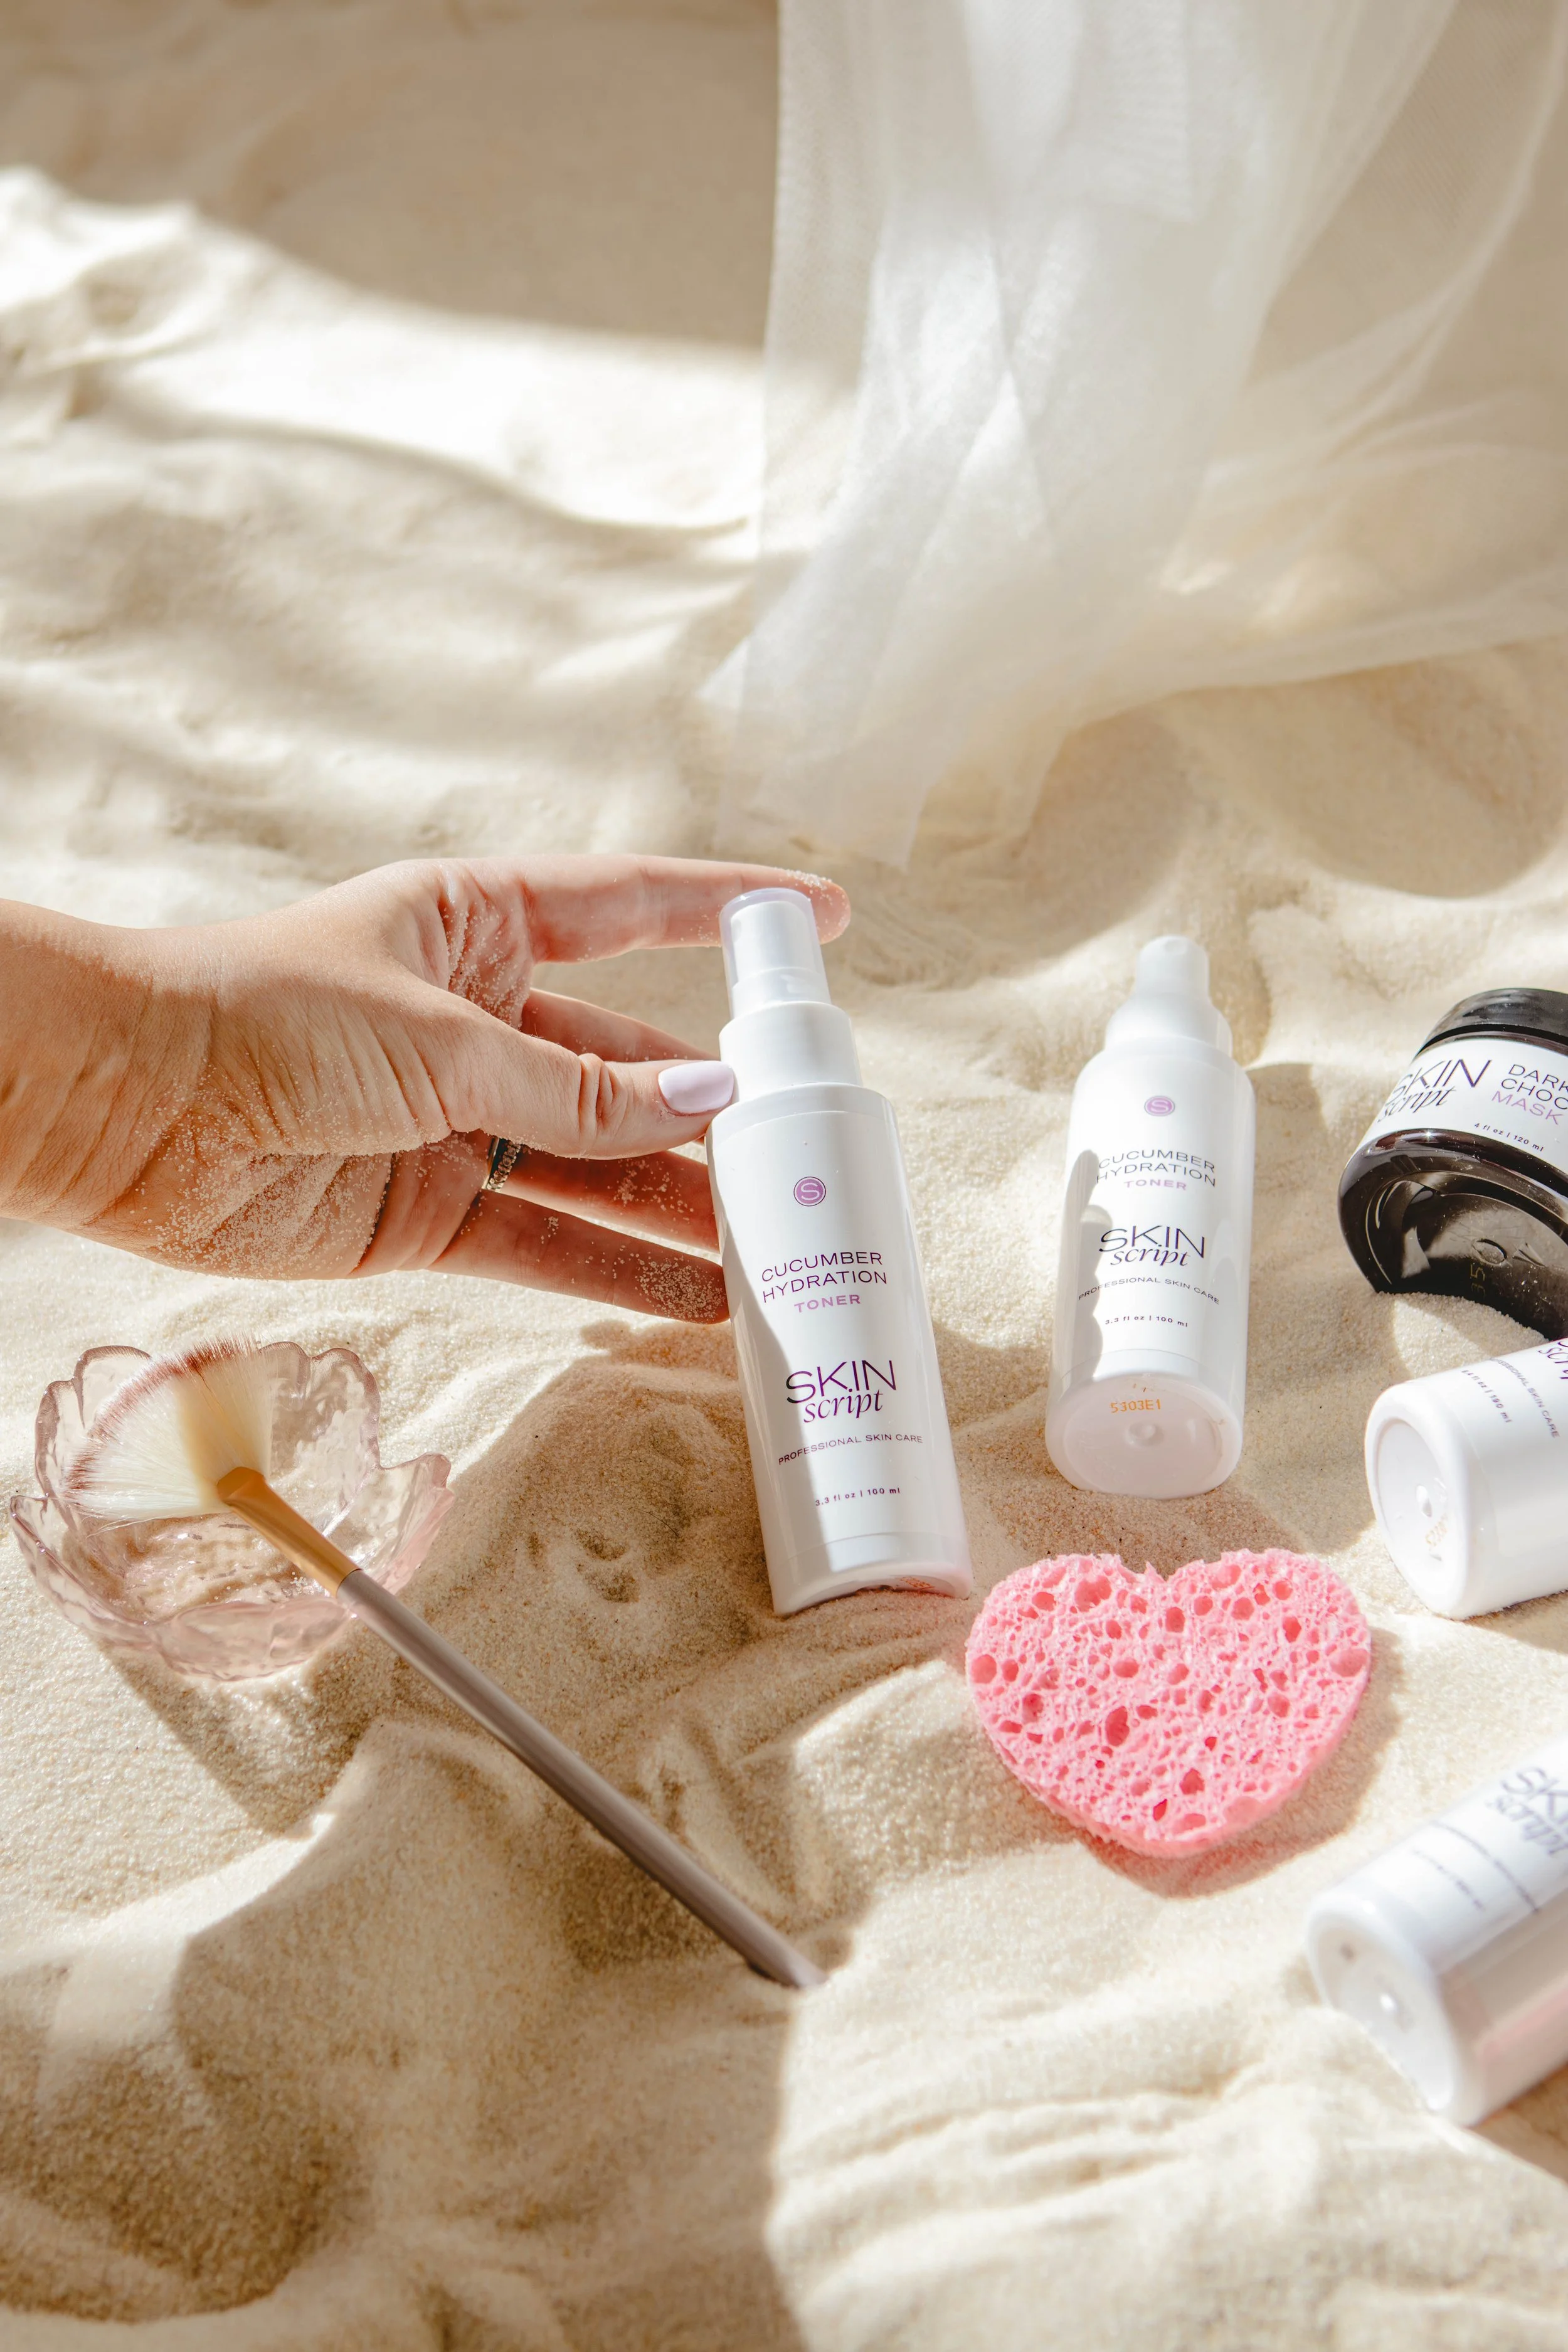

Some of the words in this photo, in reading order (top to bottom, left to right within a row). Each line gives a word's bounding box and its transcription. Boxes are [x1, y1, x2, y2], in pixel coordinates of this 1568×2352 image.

[1384, 1058, 1493, 1107] SKIN
[1491, 1091, 1564, 1125] MASK
[1513, 1135, 1530, 1145] 120
[1532, 1143, 1544, 1152] ml
[1096, 1162, 1216, 1187] HYDRATION
[1098, 1149, 1215, 1173] CUCUMBER
[1123, 1179, 1187, 1190] TONER
[1099, 1224, 1205, 1259] SKIN
[1110, 1244, 1191, 1266] script
[761, 1251, 883, 1282] CUCUMBER
[763, 1271, 887, 1303] HYDRATION
[1078, 1276, 1162, 1301] PROFESSIONAL
[1164, 1278, 1190, 1290] SKIN
[1193, 1287, 1220, 1305] CARE
[793, 1294, 861, 1313] TONER
[1104, 1317, 1120, 1325] 3.3
[1177, 1320, 1189, 1328] ml
[786, 1360, 897, 1404] SKIN
[803, 1388, 884, 1423] script
[1542, 1410, 1560, 1438] CARE
[778, 1436, 862, 1465] PROFESSIONAL
[865, 1433, 893, 1442] SKIN
[896, 1434, 924, 1443] CARE
[815, 1497, 830, 1507] 3.3
